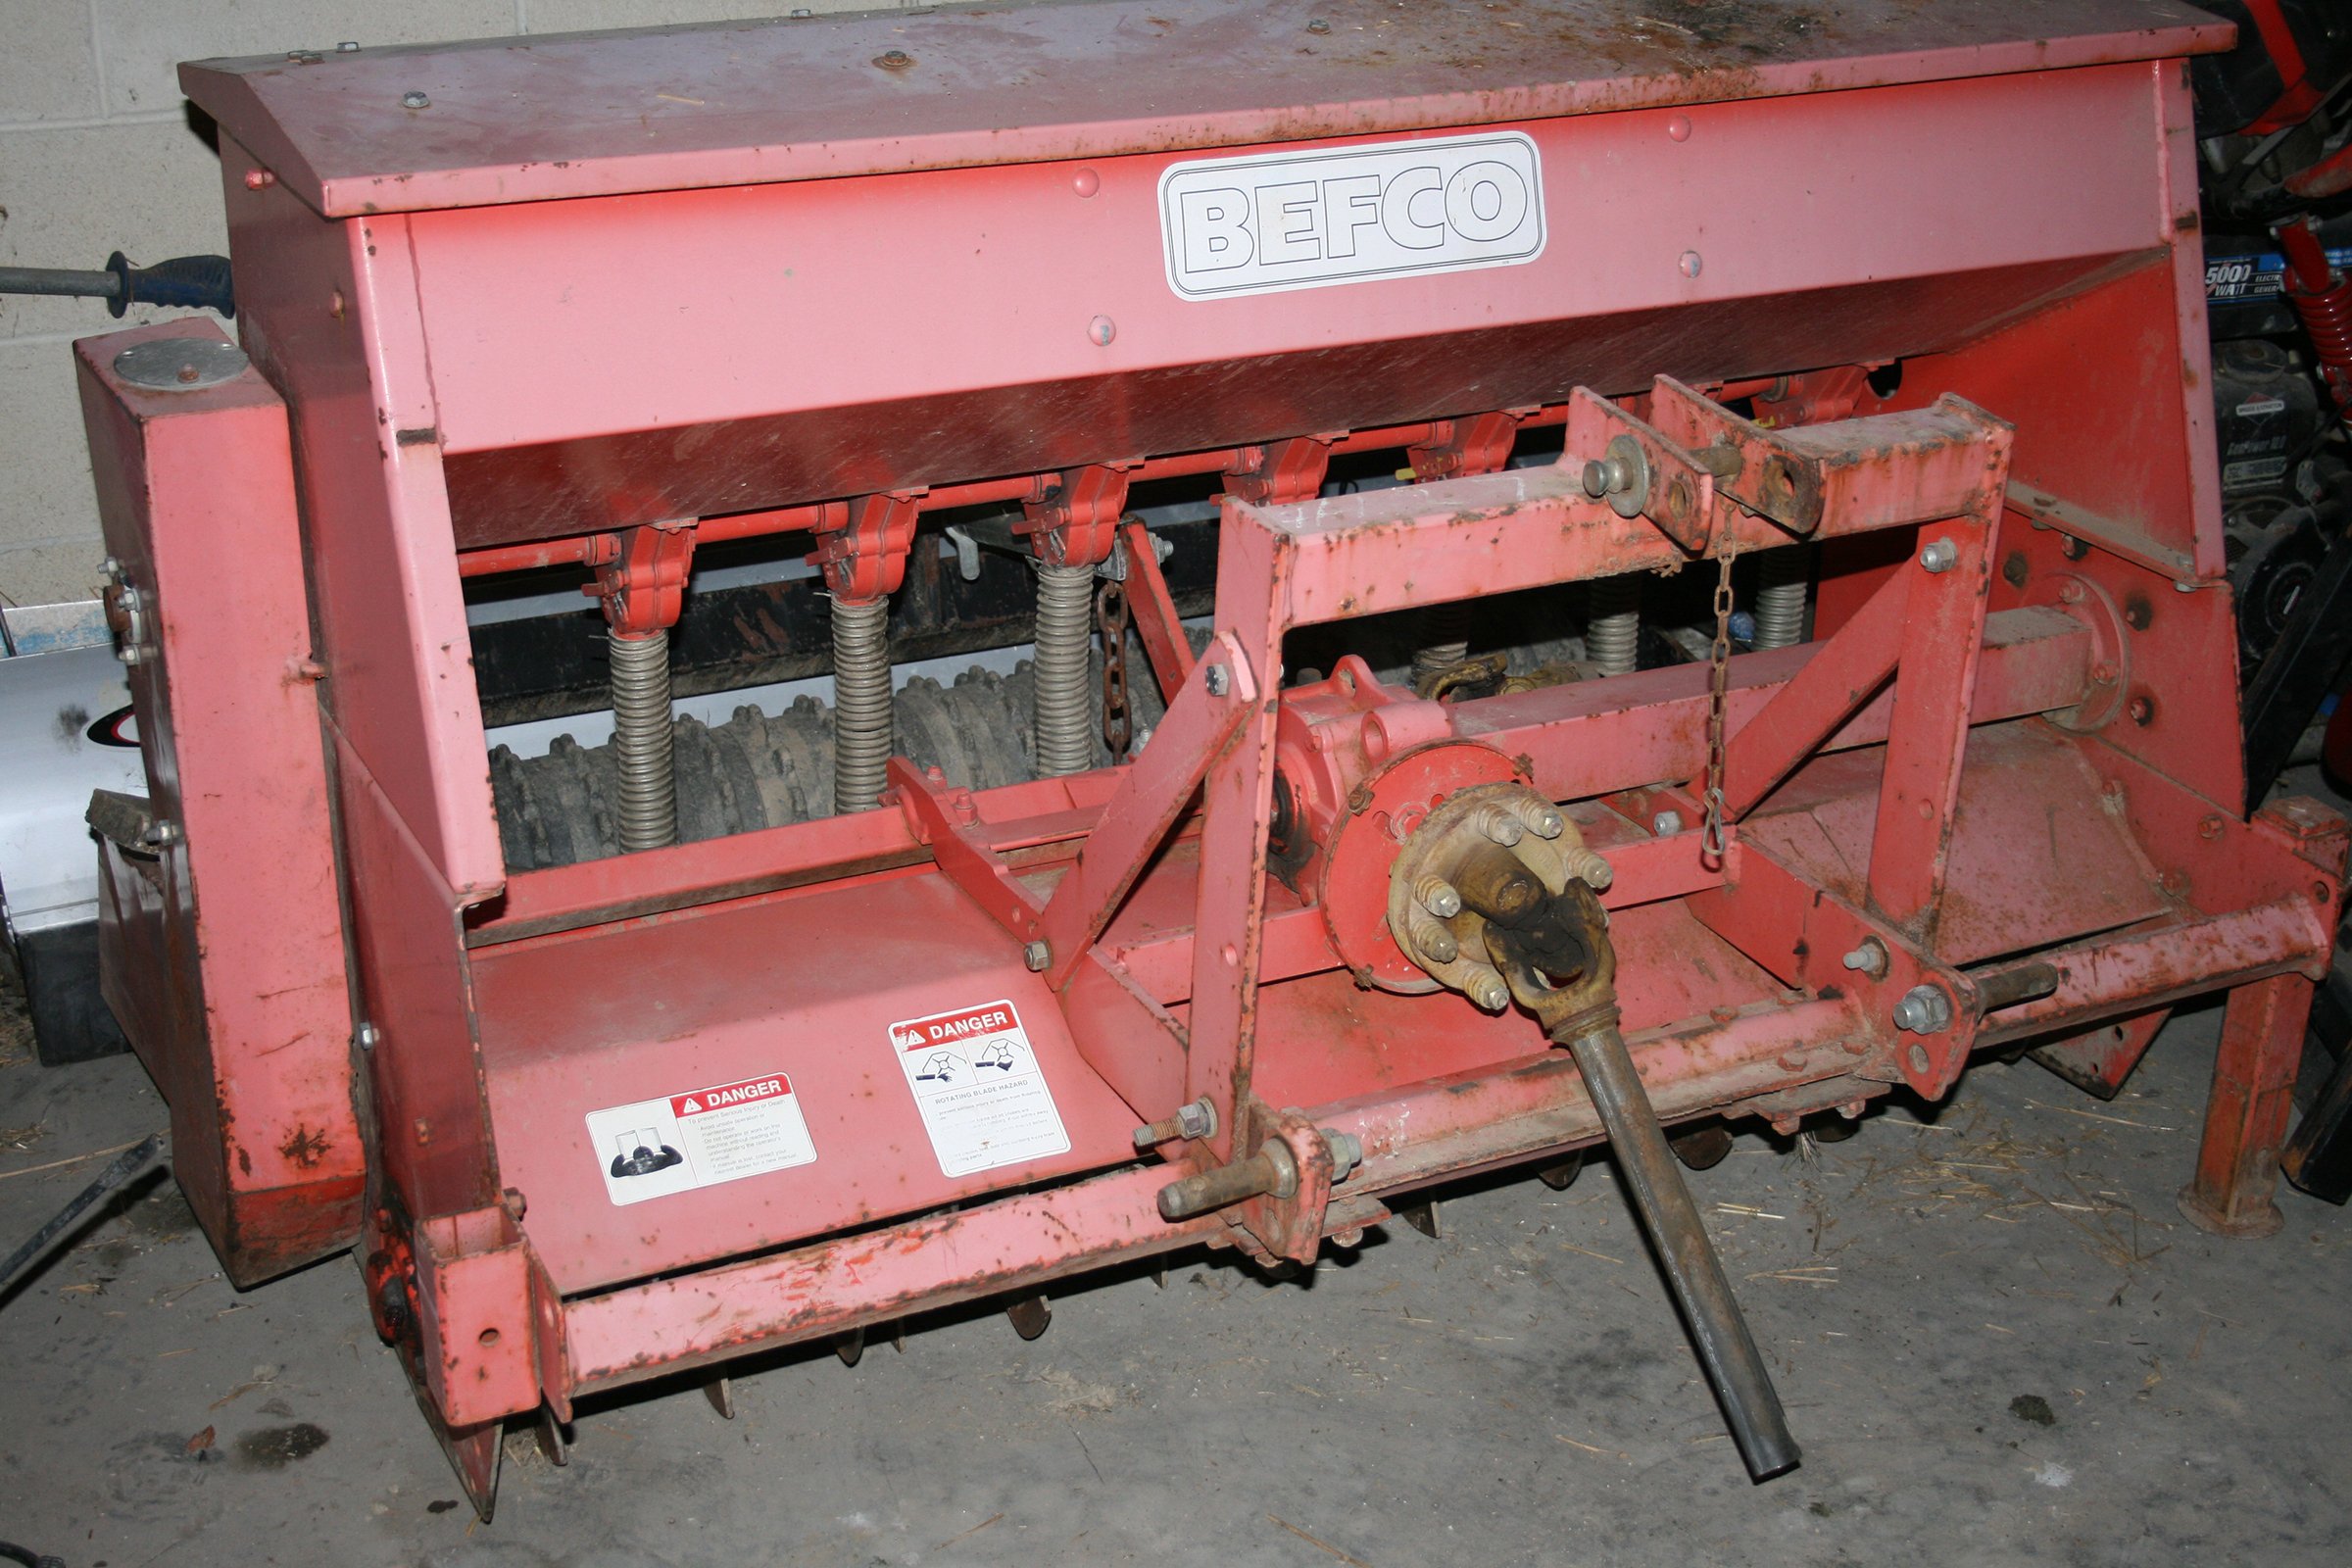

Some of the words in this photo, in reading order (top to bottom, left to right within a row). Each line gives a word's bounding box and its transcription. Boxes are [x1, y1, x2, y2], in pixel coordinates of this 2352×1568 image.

[1180, 161, 1527, 273] BEFCO
[2205, 265, 2251, 284] 5000
[2215, 283, 2246, 296] WATT
[929, 1011, 1007, 1039] DANGER
[708, 1080, 782, 1106] DANGER
[935, 1092, 972, 1104] ROTATING
[973, 1087, 998, 1097] BLADE
[999, 1080, 1029, 1091] HAZARD
